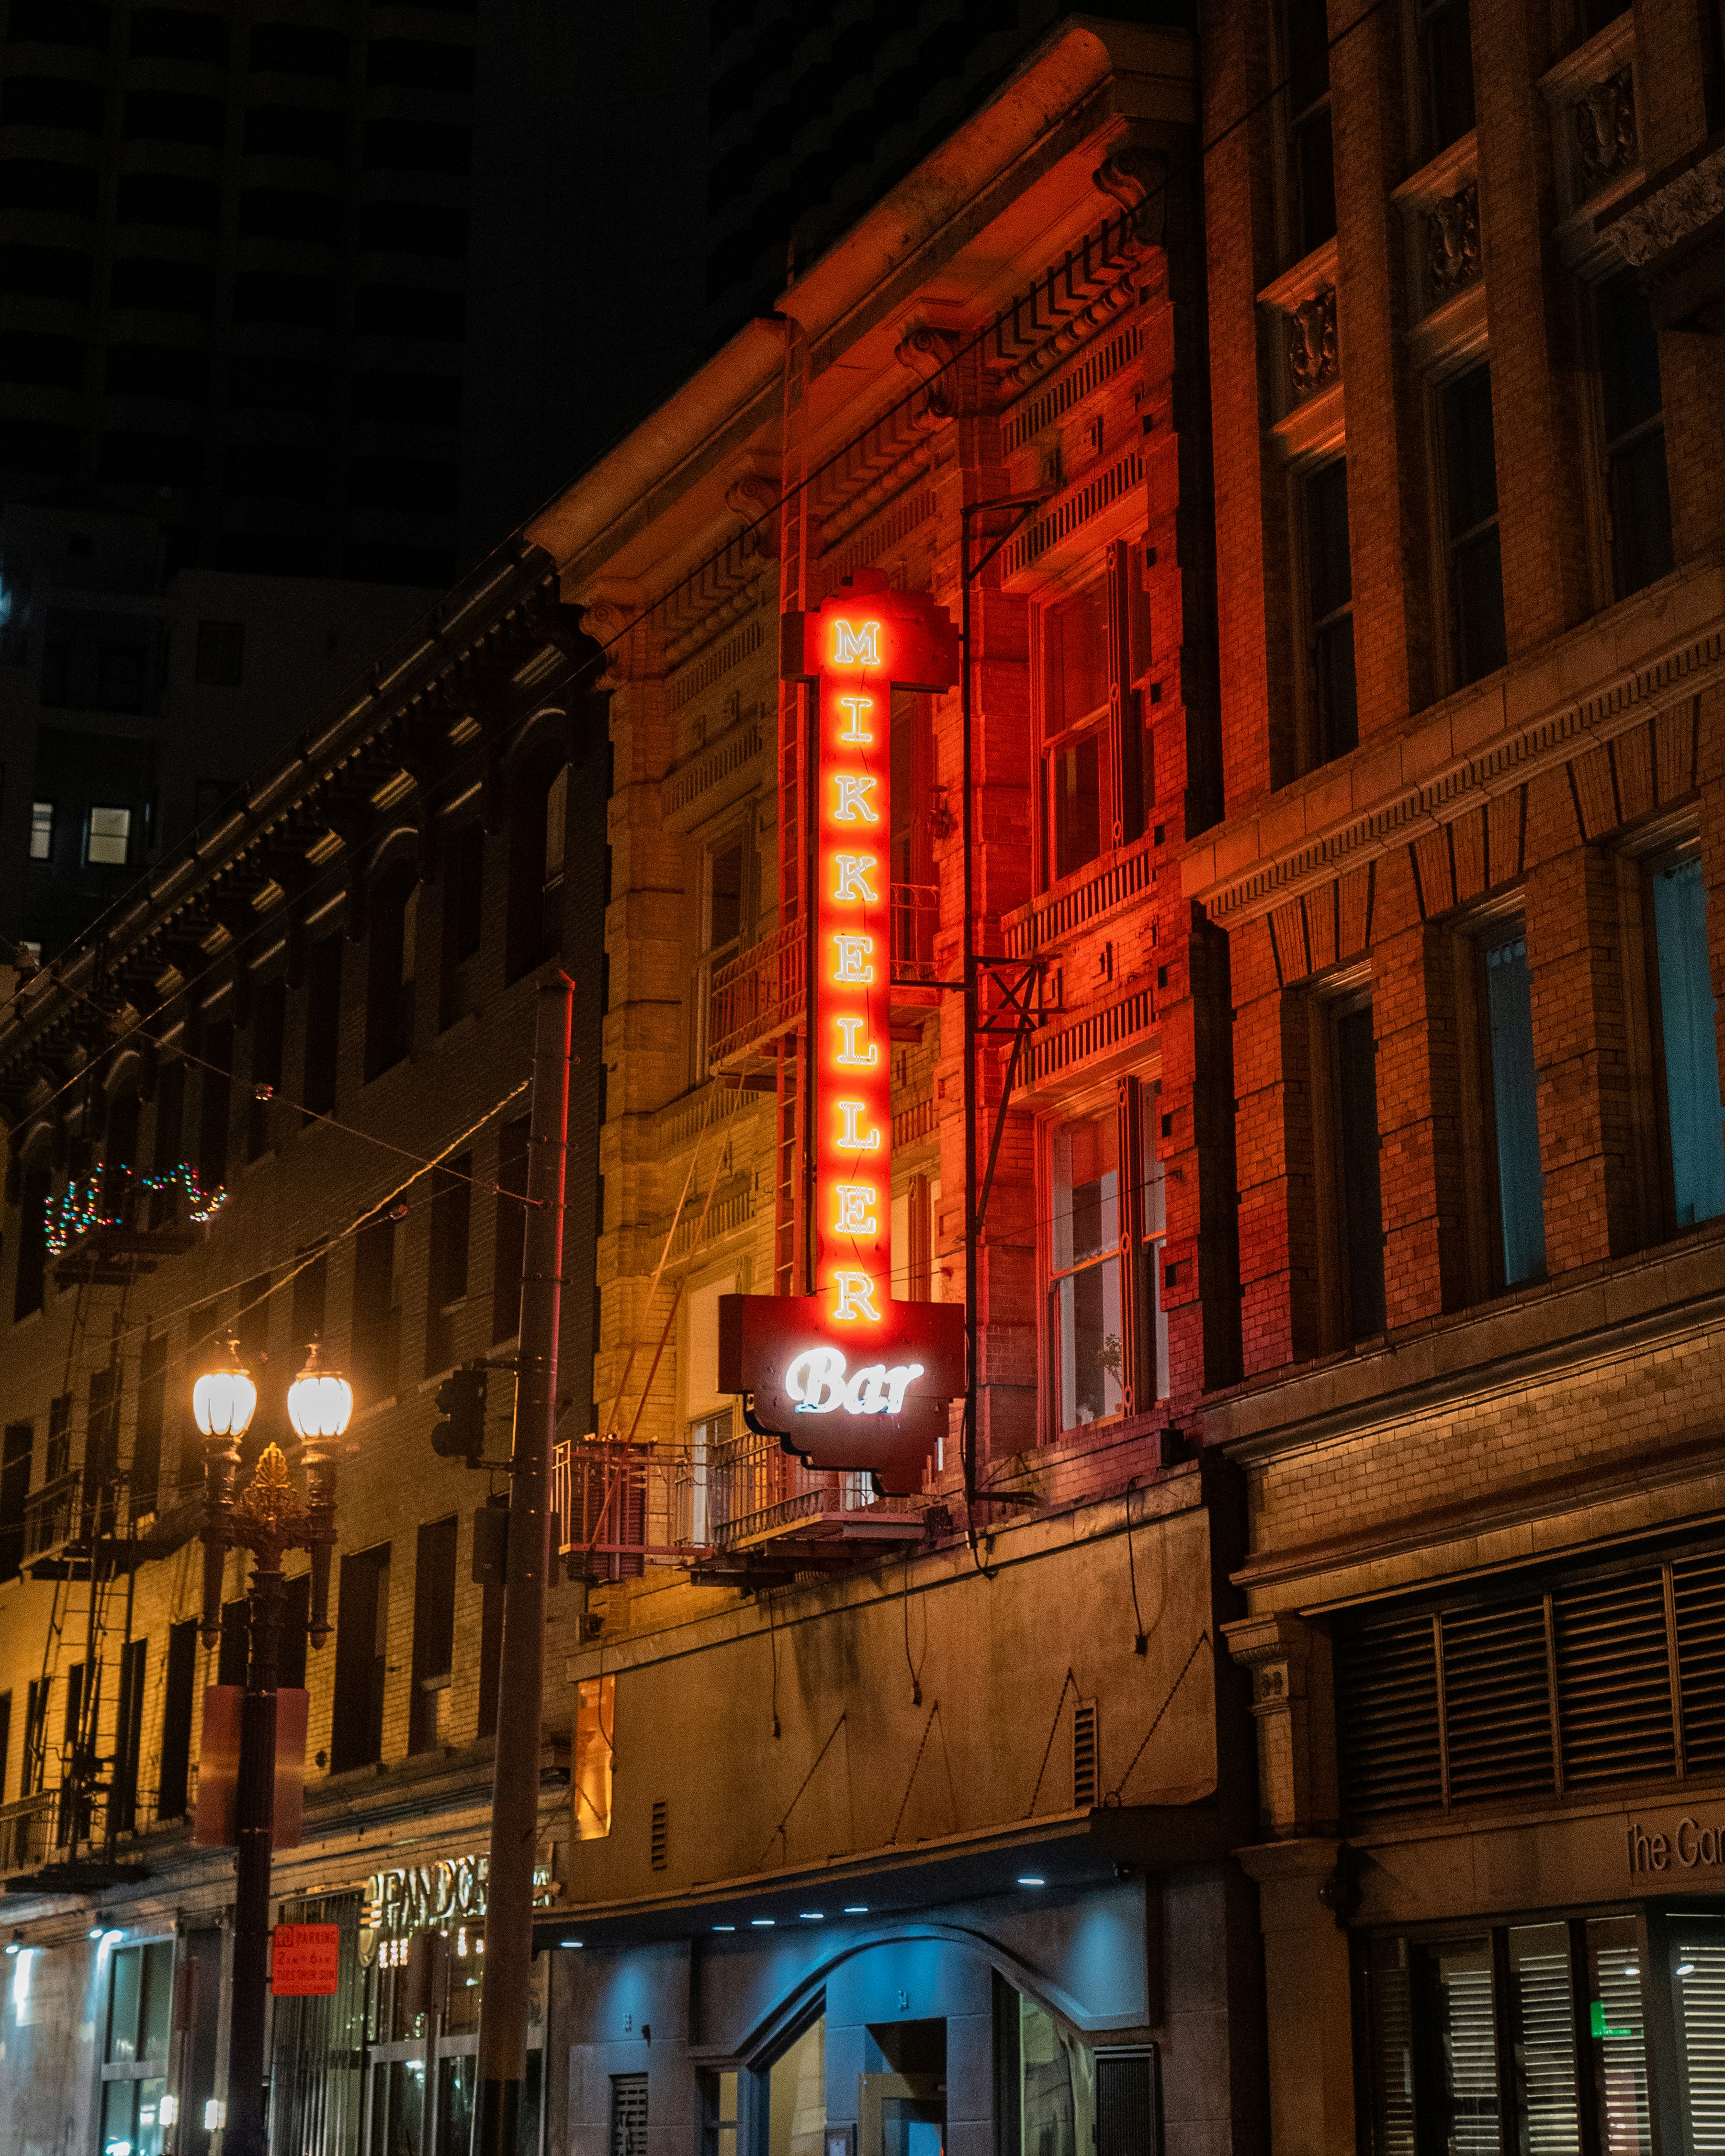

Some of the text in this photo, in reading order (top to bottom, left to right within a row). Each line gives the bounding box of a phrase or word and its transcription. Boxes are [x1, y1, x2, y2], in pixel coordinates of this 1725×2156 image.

[834, 620, 881, 1321] MIKKELLER
[785, 1347, 925, 1414] Bar
[1625, 1823, 1672, 1875] The
[297, 1931, 335, 1944] PARKING
